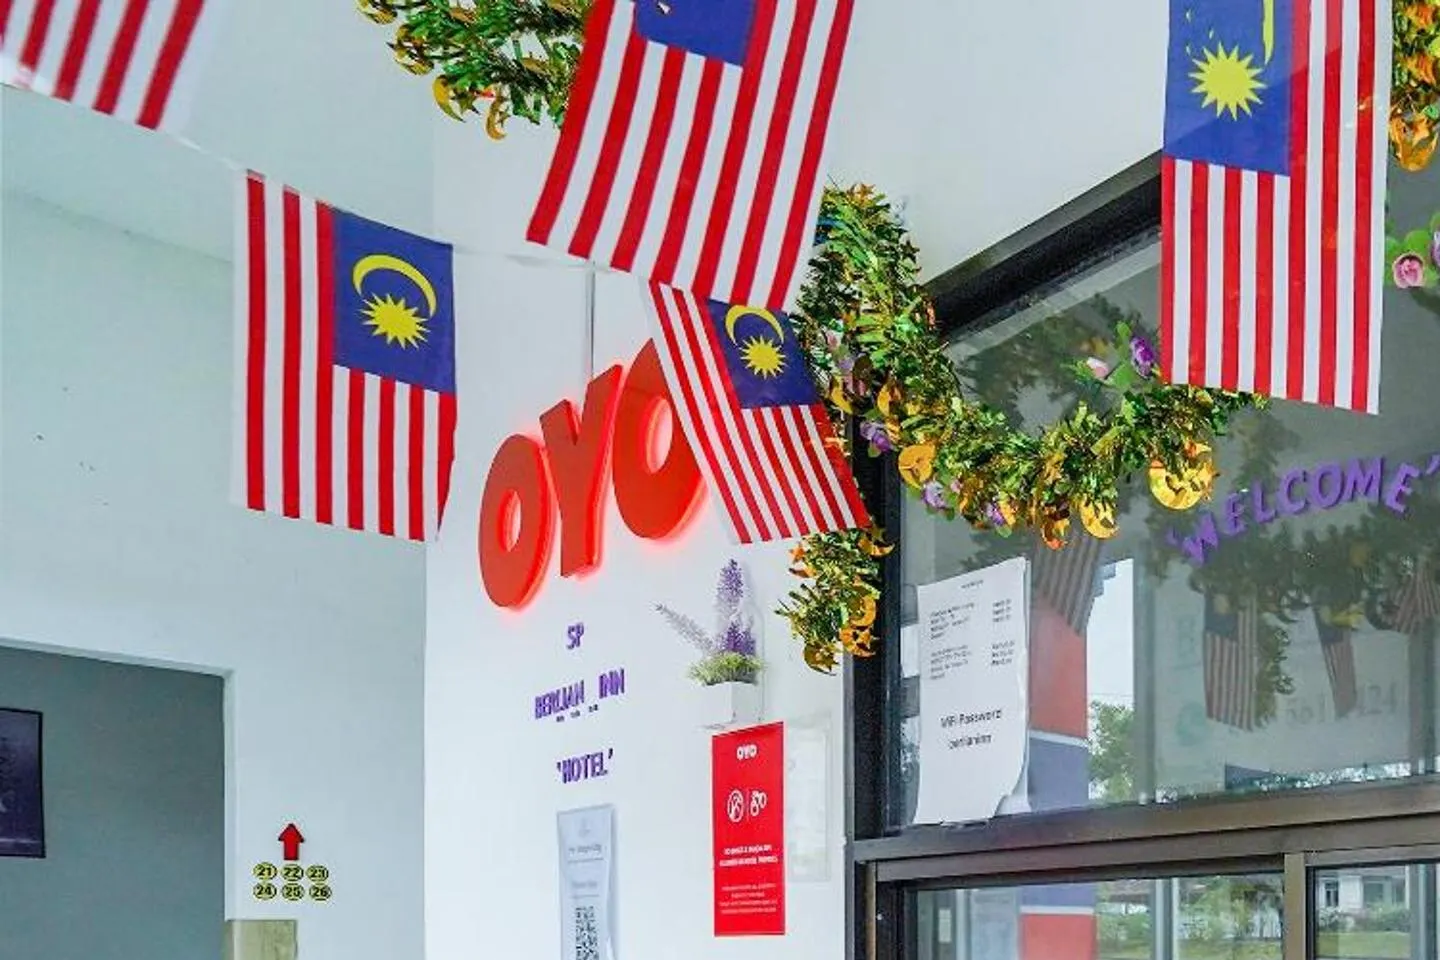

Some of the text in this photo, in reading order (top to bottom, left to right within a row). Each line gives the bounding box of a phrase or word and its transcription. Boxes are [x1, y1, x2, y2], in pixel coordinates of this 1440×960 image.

[477, 337, 706, 609] OYO
[566, 622, 585, 650] SP
[535, 680, 585, 720] BERLIAN
[598, 668, 625, 700] INN
[736, 744, 758, 761] OYO
